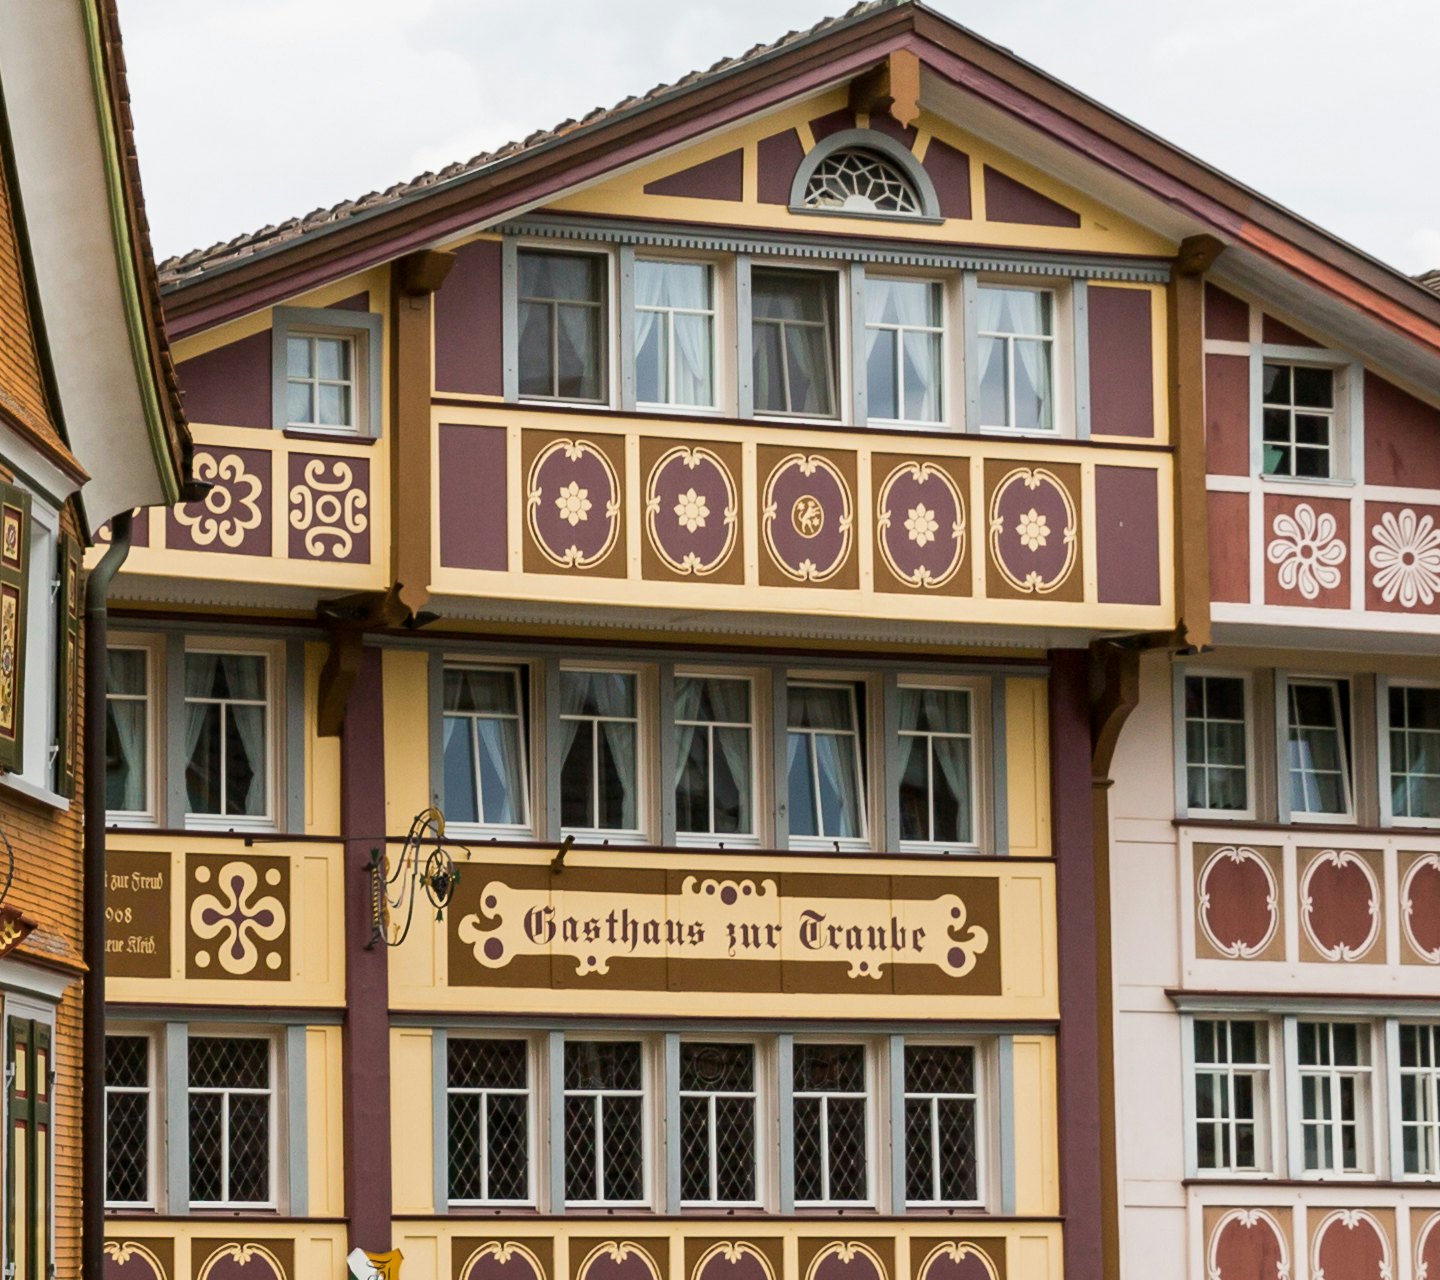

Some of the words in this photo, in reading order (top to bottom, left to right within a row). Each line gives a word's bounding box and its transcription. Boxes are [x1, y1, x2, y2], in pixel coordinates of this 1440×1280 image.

[111, 874, 129, 891] zur
[523, 904, 706, 953] Gasthaus
[726, 921, 783, 957] zur
[799, 909, 927, 953] Traube
